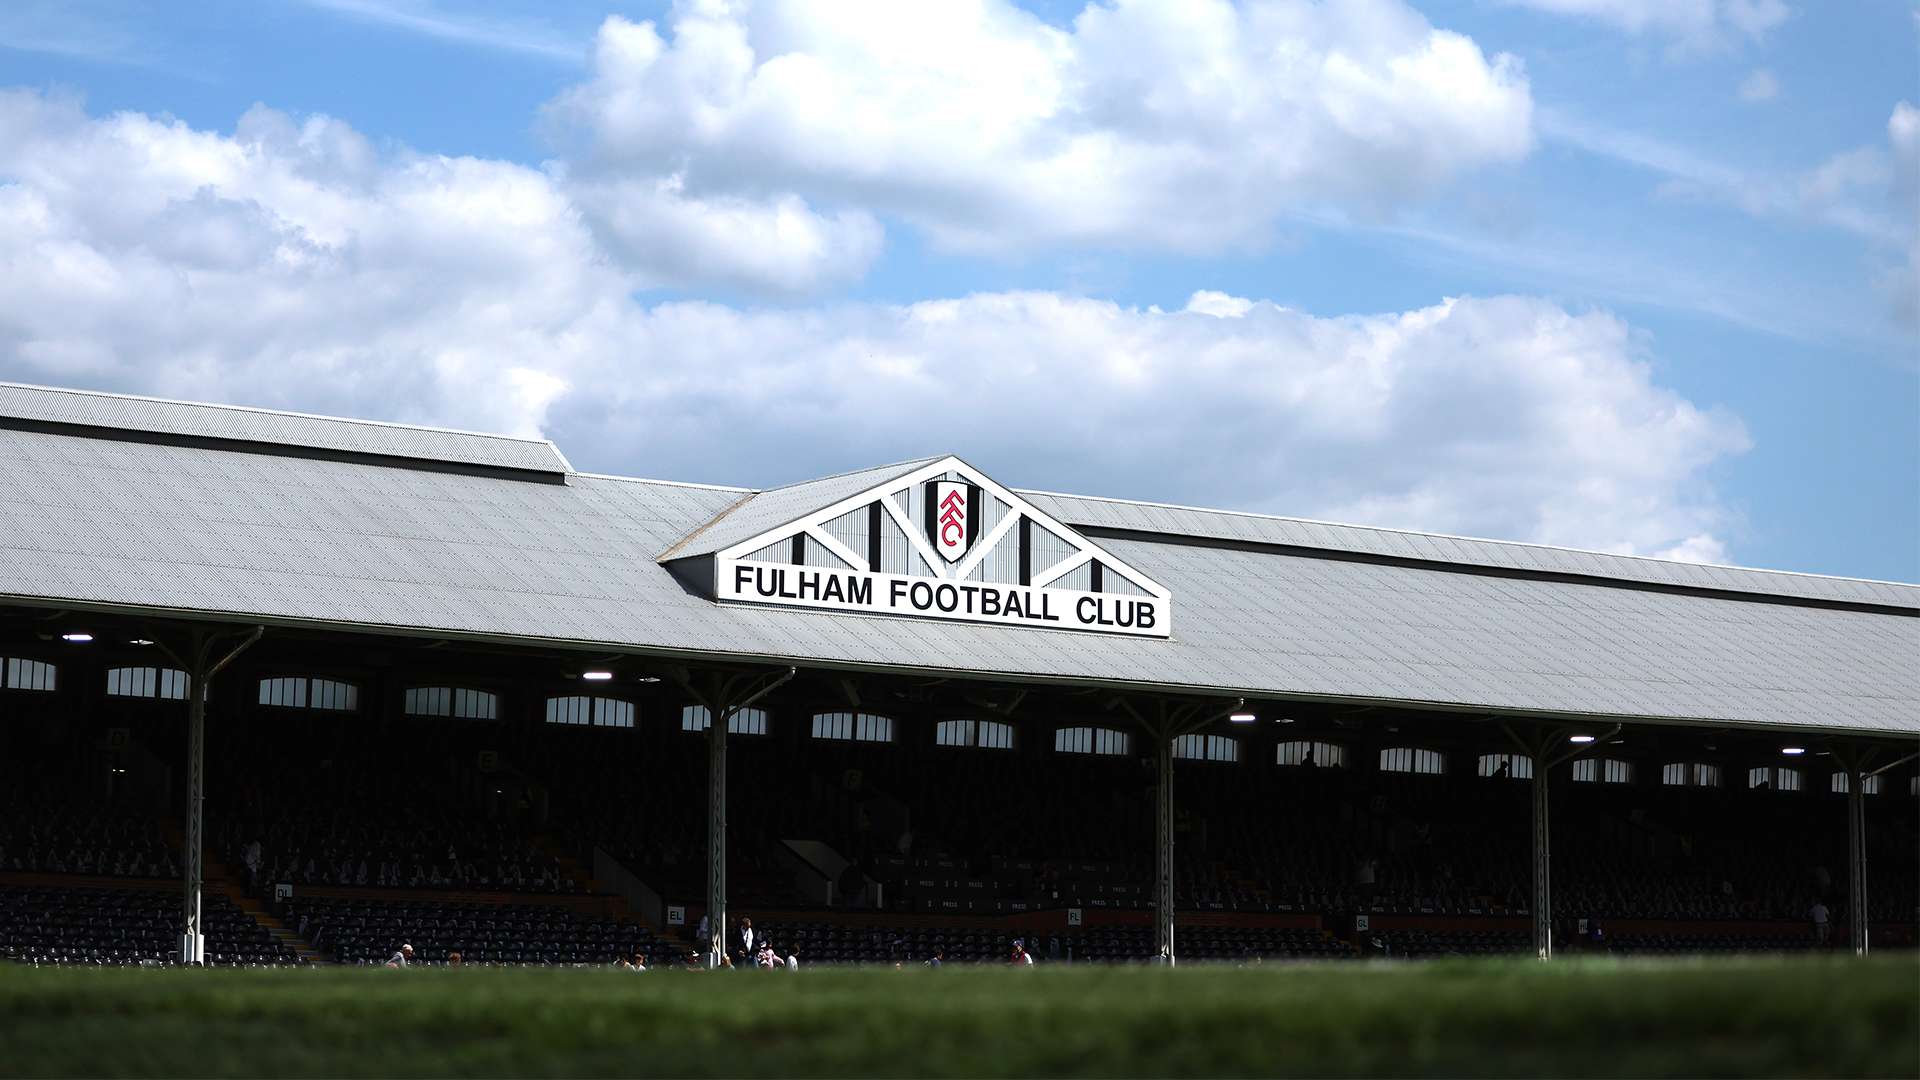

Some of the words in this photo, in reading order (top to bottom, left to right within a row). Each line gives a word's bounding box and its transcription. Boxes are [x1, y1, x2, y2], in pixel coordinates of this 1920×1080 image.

[939, 489, 965, 547] FFC
[735, 565, 872, 605] FULHAM
[890, 579, 1060, 621] FOOTBALL
[1076, 596, 1156, 629] CLUB
[670, 911, 682, 920] EL
[1069, 912, 1080, 921] FL
[1358, 919, 1368, 928] GL
